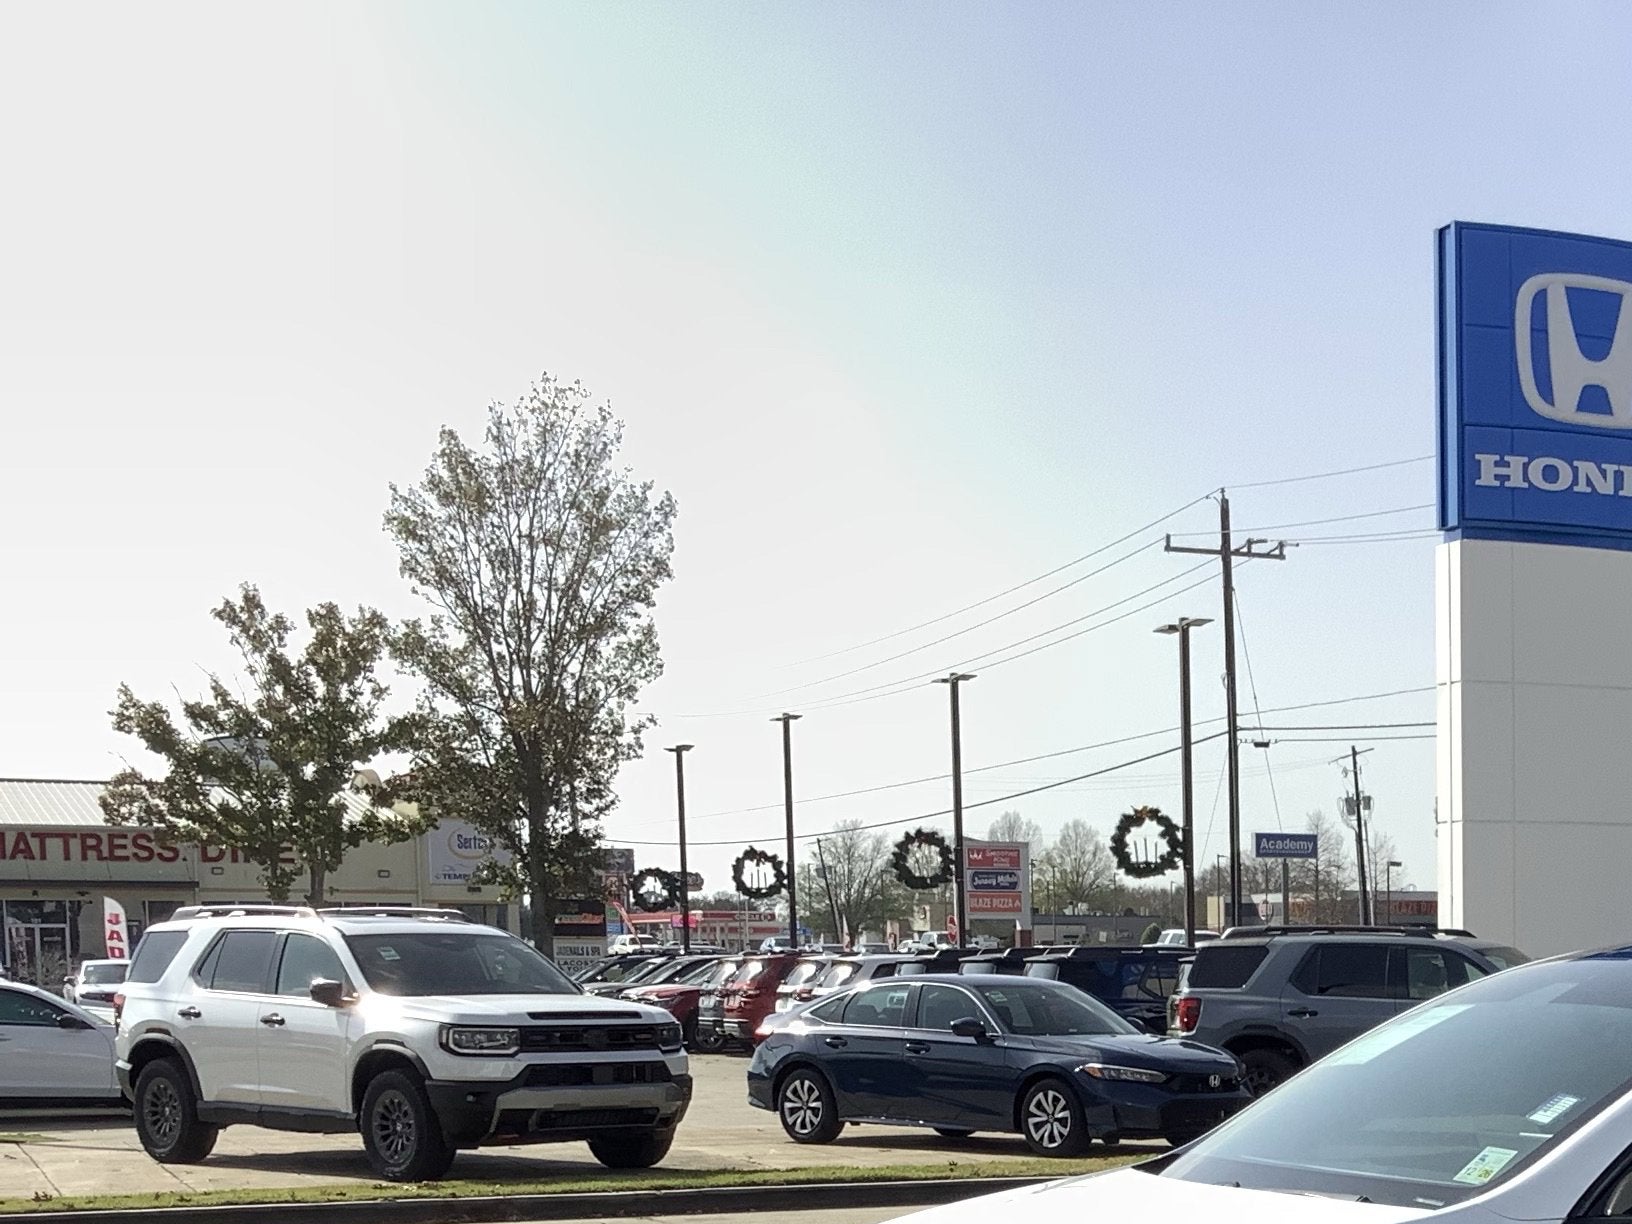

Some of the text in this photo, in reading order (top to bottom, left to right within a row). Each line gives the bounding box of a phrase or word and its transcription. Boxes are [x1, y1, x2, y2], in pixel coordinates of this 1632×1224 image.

[1260, 838, 1314, 853] Academy
[970, 897, 1013, 909] BLAZE PIZZA
